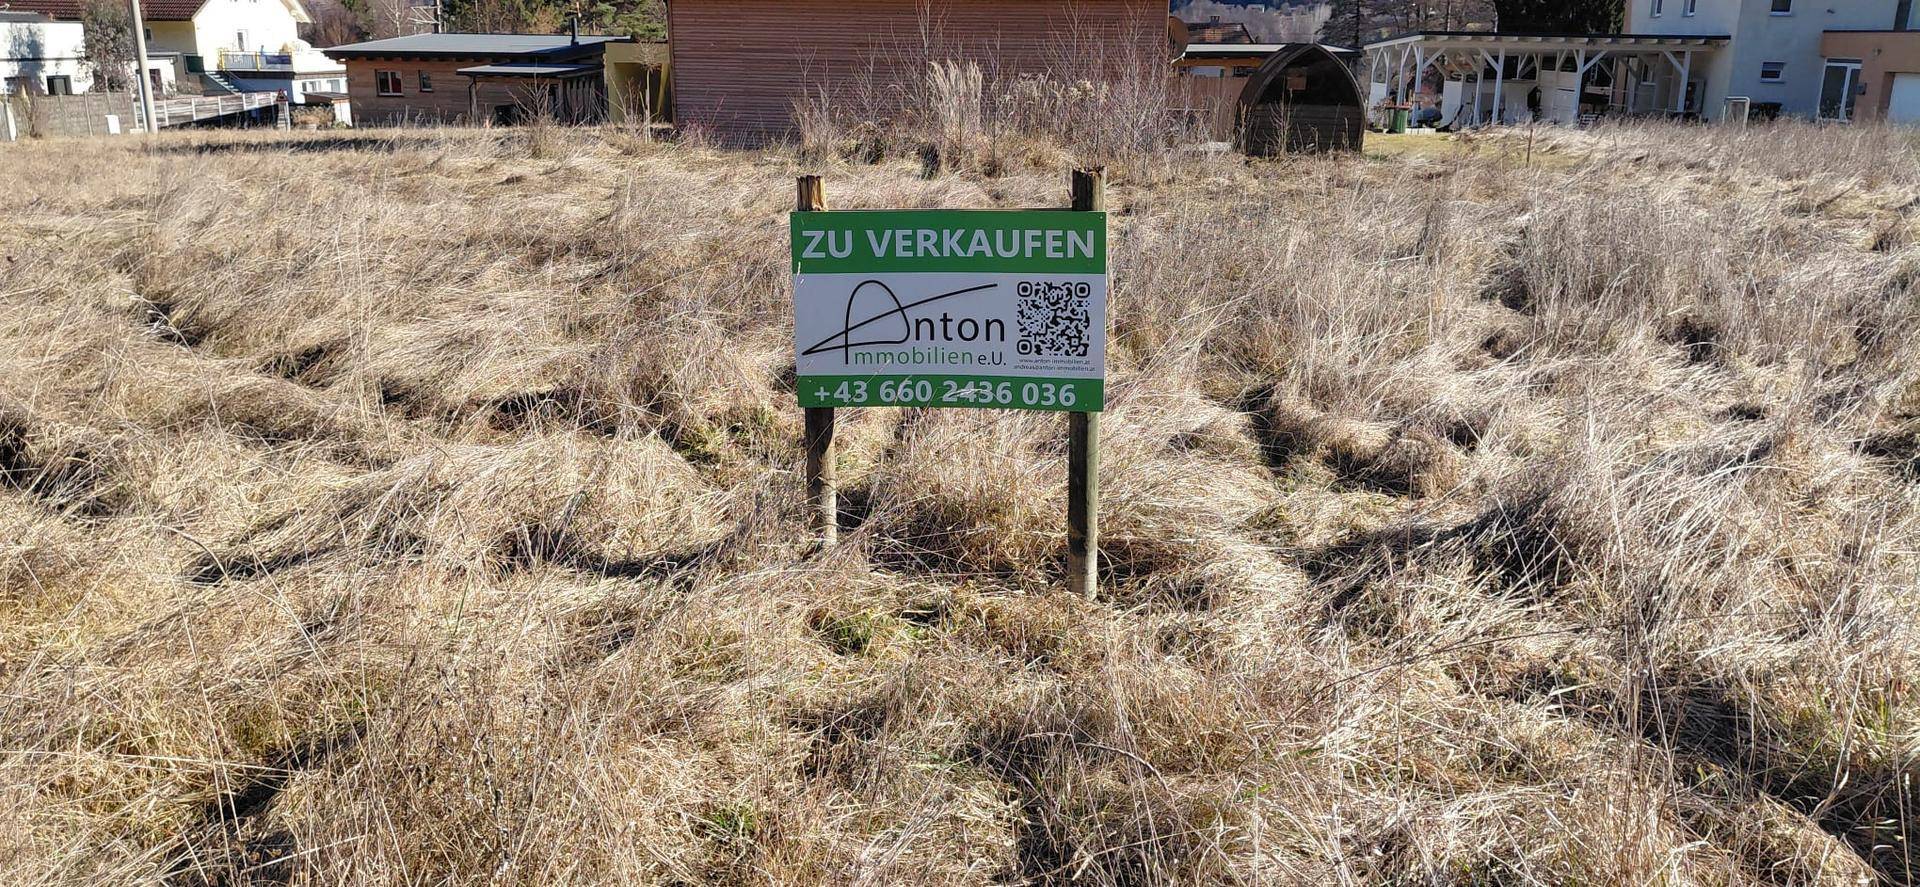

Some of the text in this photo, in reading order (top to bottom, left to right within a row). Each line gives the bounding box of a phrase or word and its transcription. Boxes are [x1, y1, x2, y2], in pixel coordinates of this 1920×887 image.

[802, 229, 1095, 259] ZU VERKAUFEN
[801, 280, 1006, 365] Anton
[977, 351, 1007, 365] e.U.
[814, 380, 1077, 407] +43 660 2436 036
